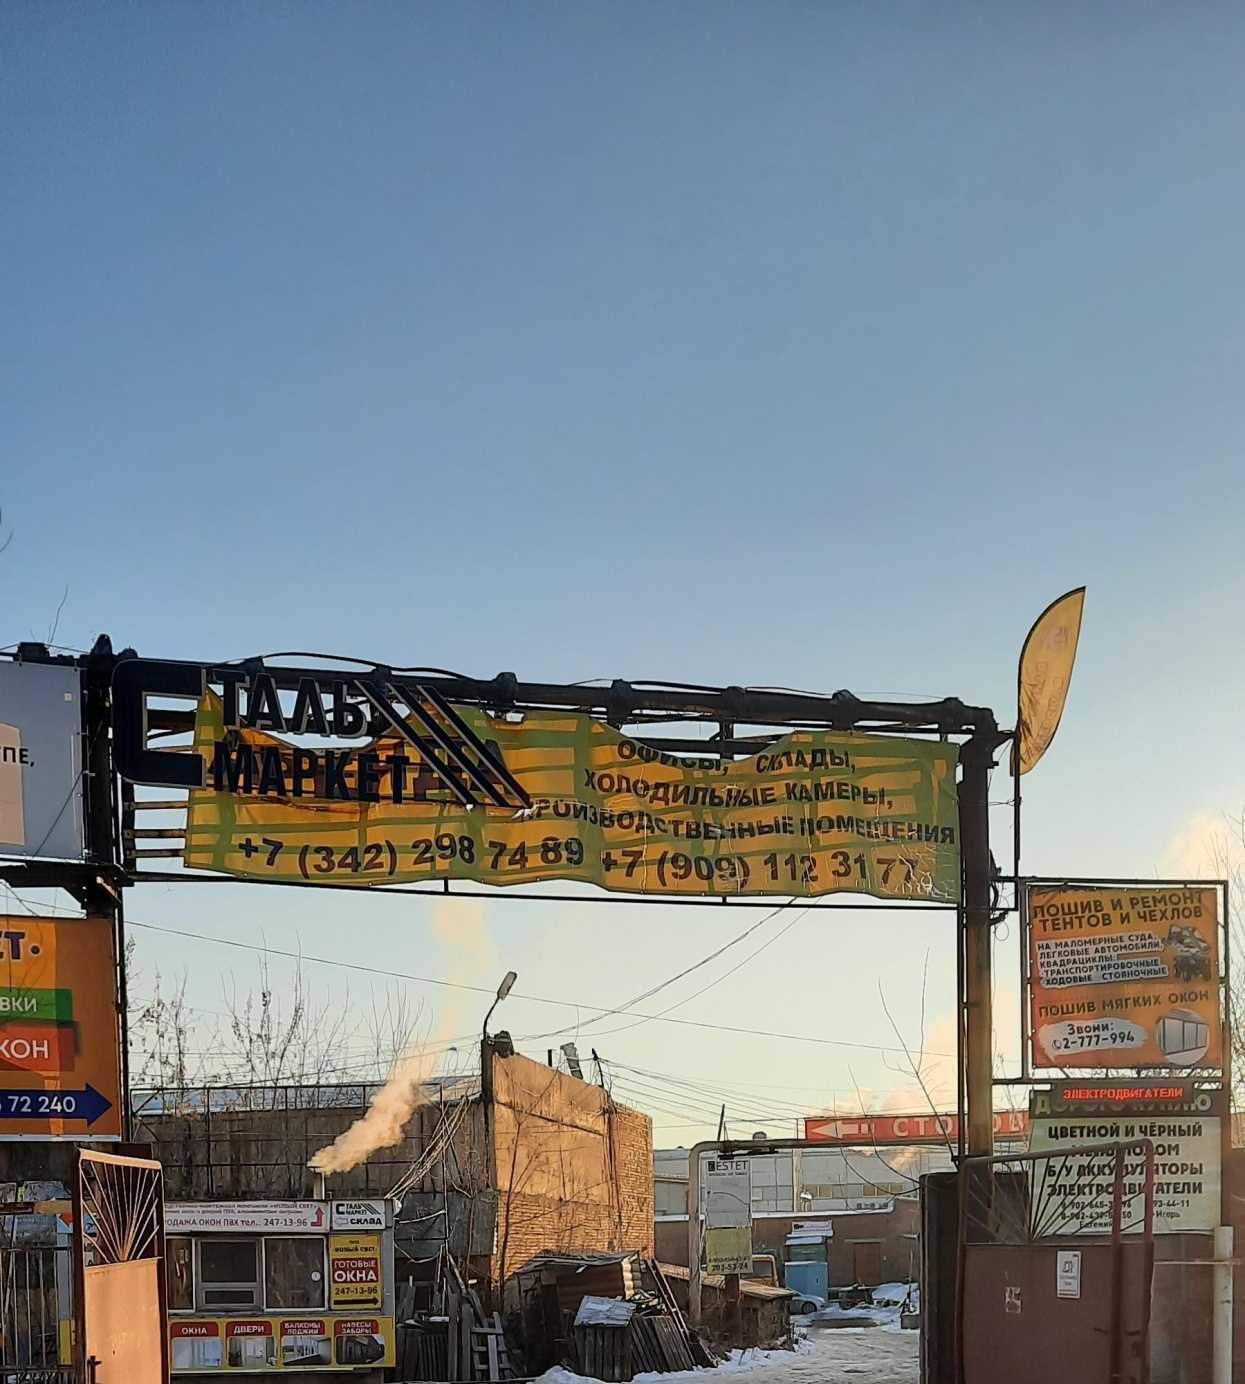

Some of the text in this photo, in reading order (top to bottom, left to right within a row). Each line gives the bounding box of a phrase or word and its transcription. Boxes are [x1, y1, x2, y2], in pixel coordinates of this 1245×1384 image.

[0, 746, 35, 768] ПЕ,
[213, 741, 410, 804] МАРКЕТ
[585, 768, 893, 809] ХОЛОДИЛЬНЫЕ КАМЕРЫ,
[533, 799, 955, 845] РОИЗВОДСТВЕННЫЕ ПОМЕЩЕНИЯ
[238, 833, 918, 889] +7 (342) 298 74 89 +7 (909) 112 31 77
[1033, 891, 1203, 919] ПОШИВ И РЕМОНТ
[1039, 905, 1203, 932] ТЕНТОВ И ЧЕХЛОВ
[1037, 942, 1051, 951] НА
[1054, 935, 1125, 949] МАЛОМЕРНЫЕ
[1039, 948, 1090, 960] ЛЕГКОВЫЕ
[1039, 990, 1209, 1018] ПОШИВ МЯГКИХ ОКОН
[1067, 1022, 1115, 1035] Звони:
[1062, 1032, 1135, 1050] 2-777-994
[1063, 1087, 1184, 1100] ЭЛЕКТРОДВИГАТЕЛИ
[7, 1095, 76, 1113] 72 240
[1048, 1122, 1203, 1140] ЦВЕТНОЙ И ЧЁРНЫЙ
[716, 1160, 749, 1171] ESTET
[1047, 1182, 1203, 1197] ЭЛЕКТРОВАТЕЛИ
[166, 1218, 198, 1227] ОДАЖА
[263, 1218, 308, 1227] 247-13-96
[334, 1260, 377, 1268] ГОТОВЫЕ
[334, 1270, 378, 1282] ОКНА
[335, 1286, 378, 1295] 247-13-96
[181, 1327, 208, 1335] ОКНА
[233, 1325, 265, 1334] ДВЕРИ
